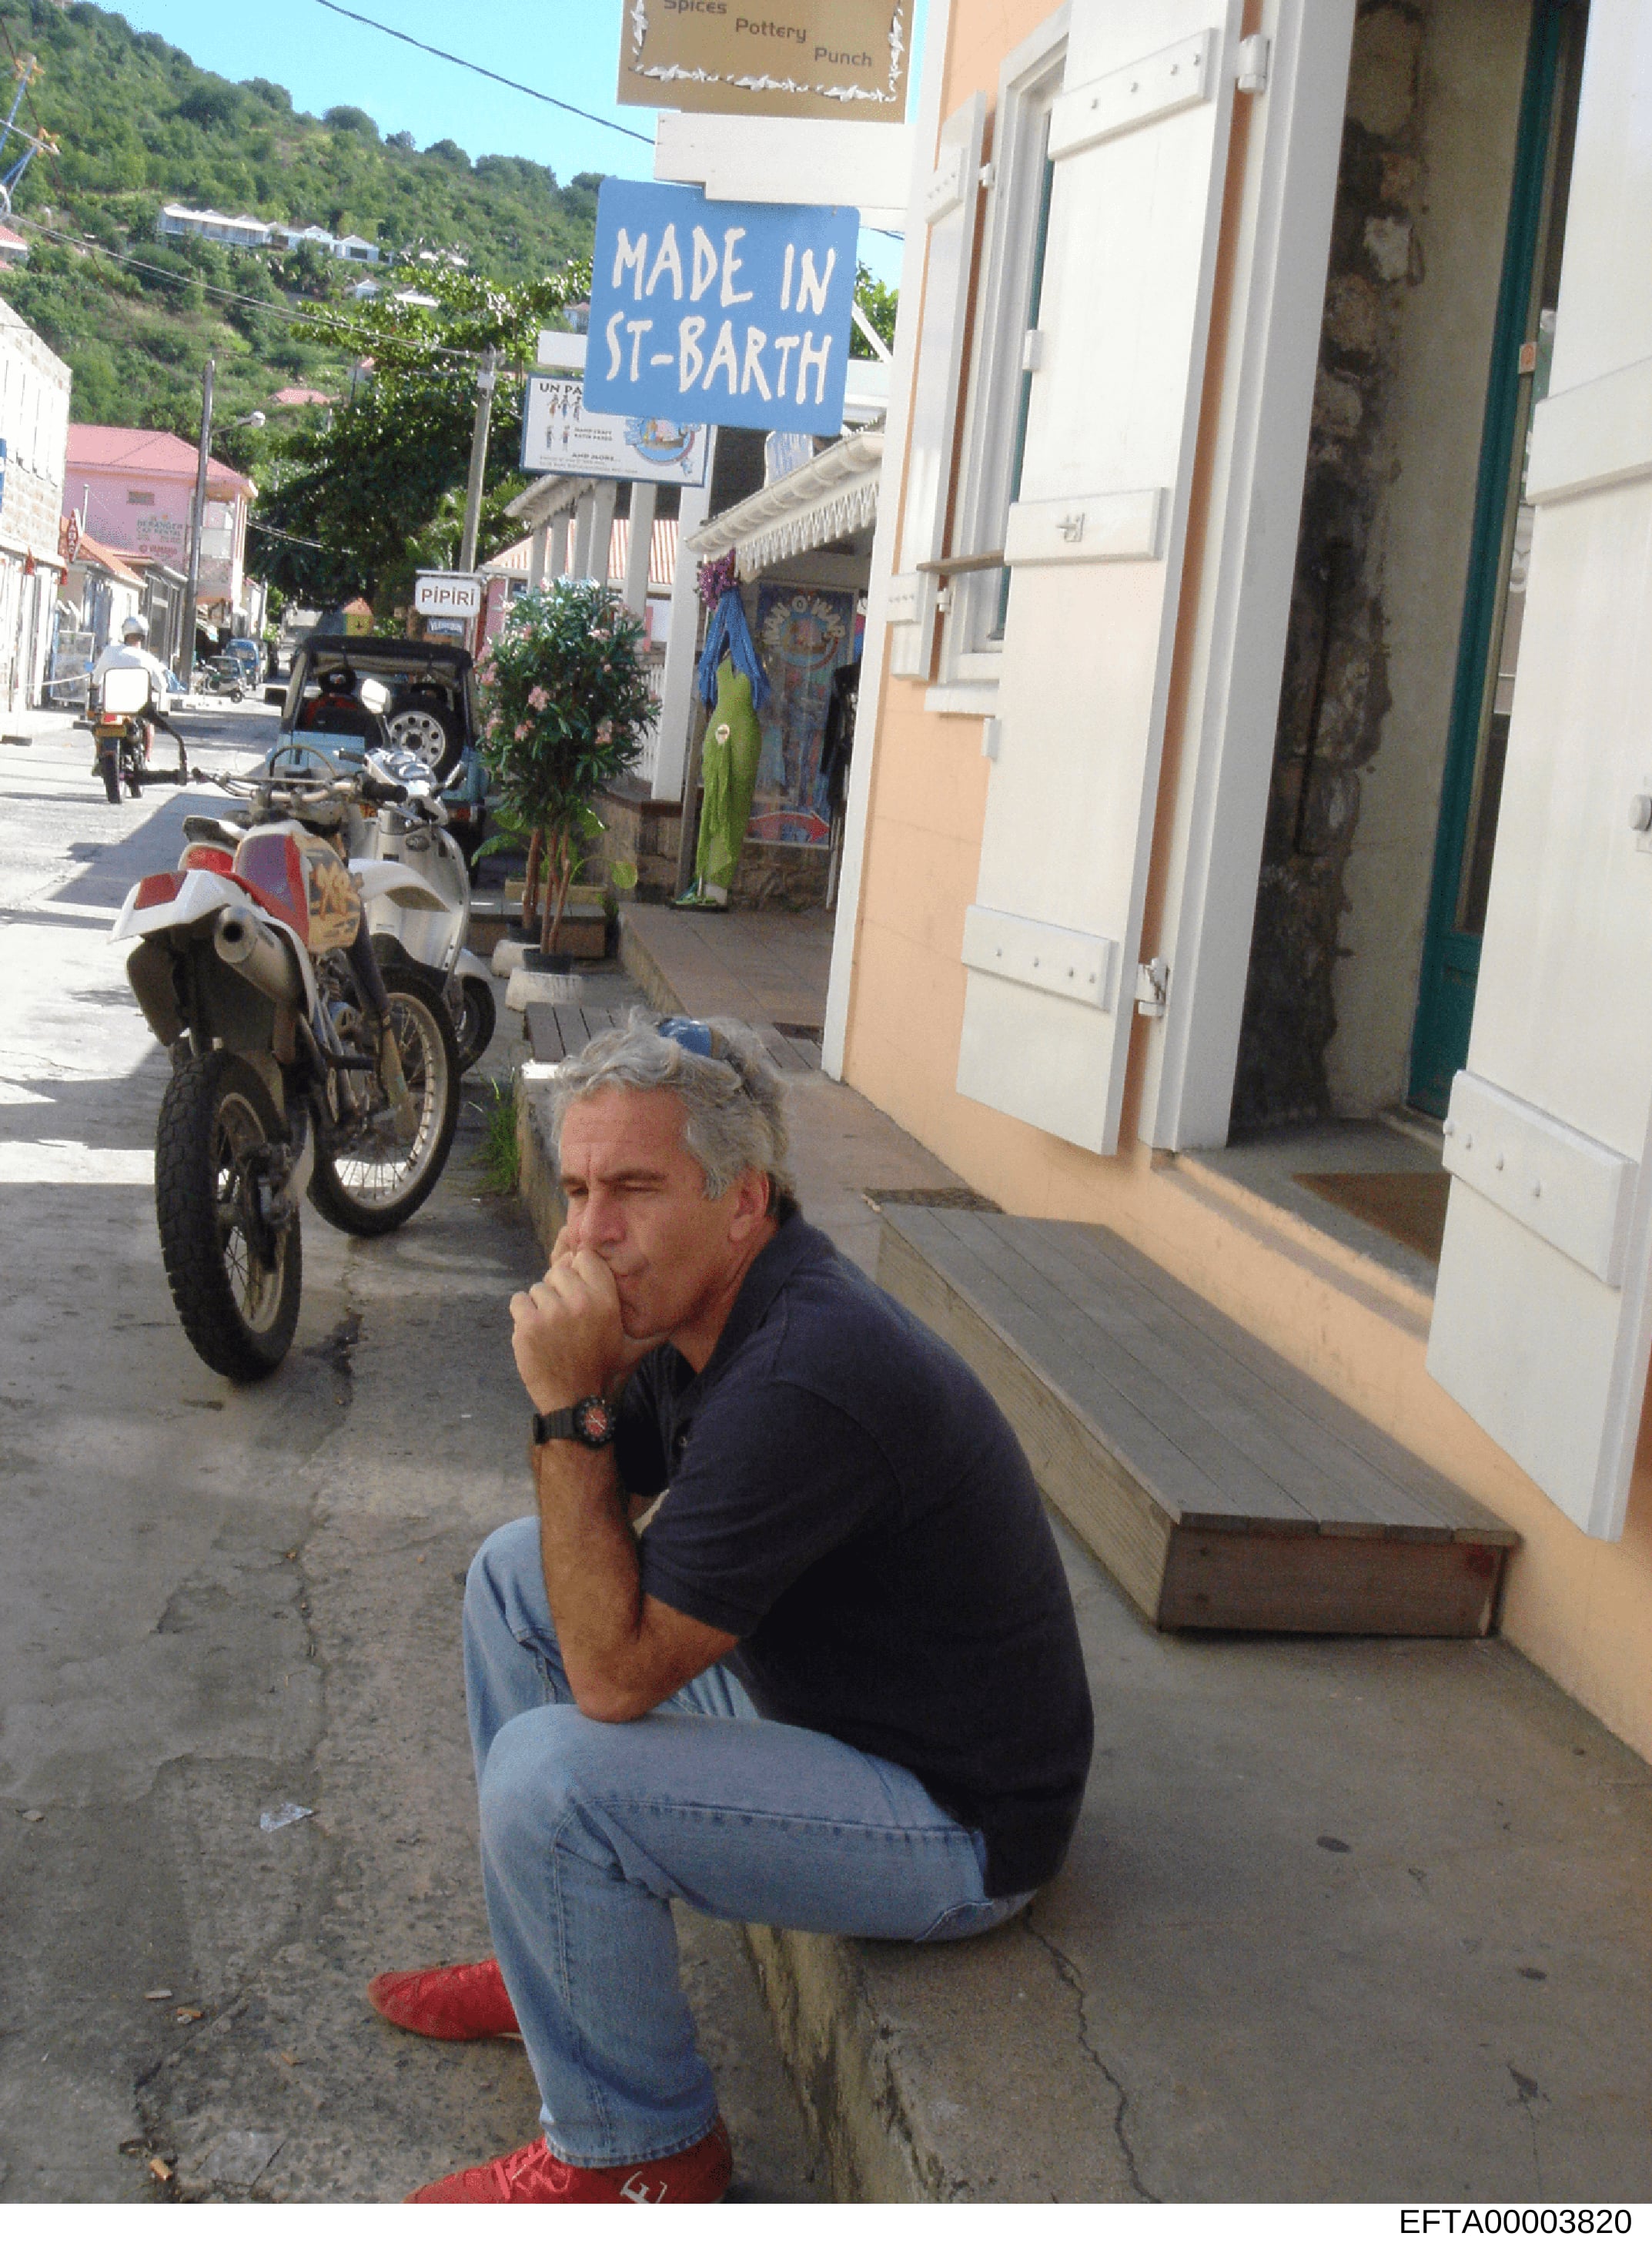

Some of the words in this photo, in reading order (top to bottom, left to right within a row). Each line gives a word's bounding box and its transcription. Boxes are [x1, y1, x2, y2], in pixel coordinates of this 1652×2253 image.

[664, 0, 727, 14] Spices
[735, 18, 807, 43] Pottery
[814, 46, 873, 67] Punch
[612, 223, 754, 307] MADE
[780, 243, 836, 315] IN
[606, 311, 833, 404] ST-BARTH
[540, 383, 560, 393] UN
